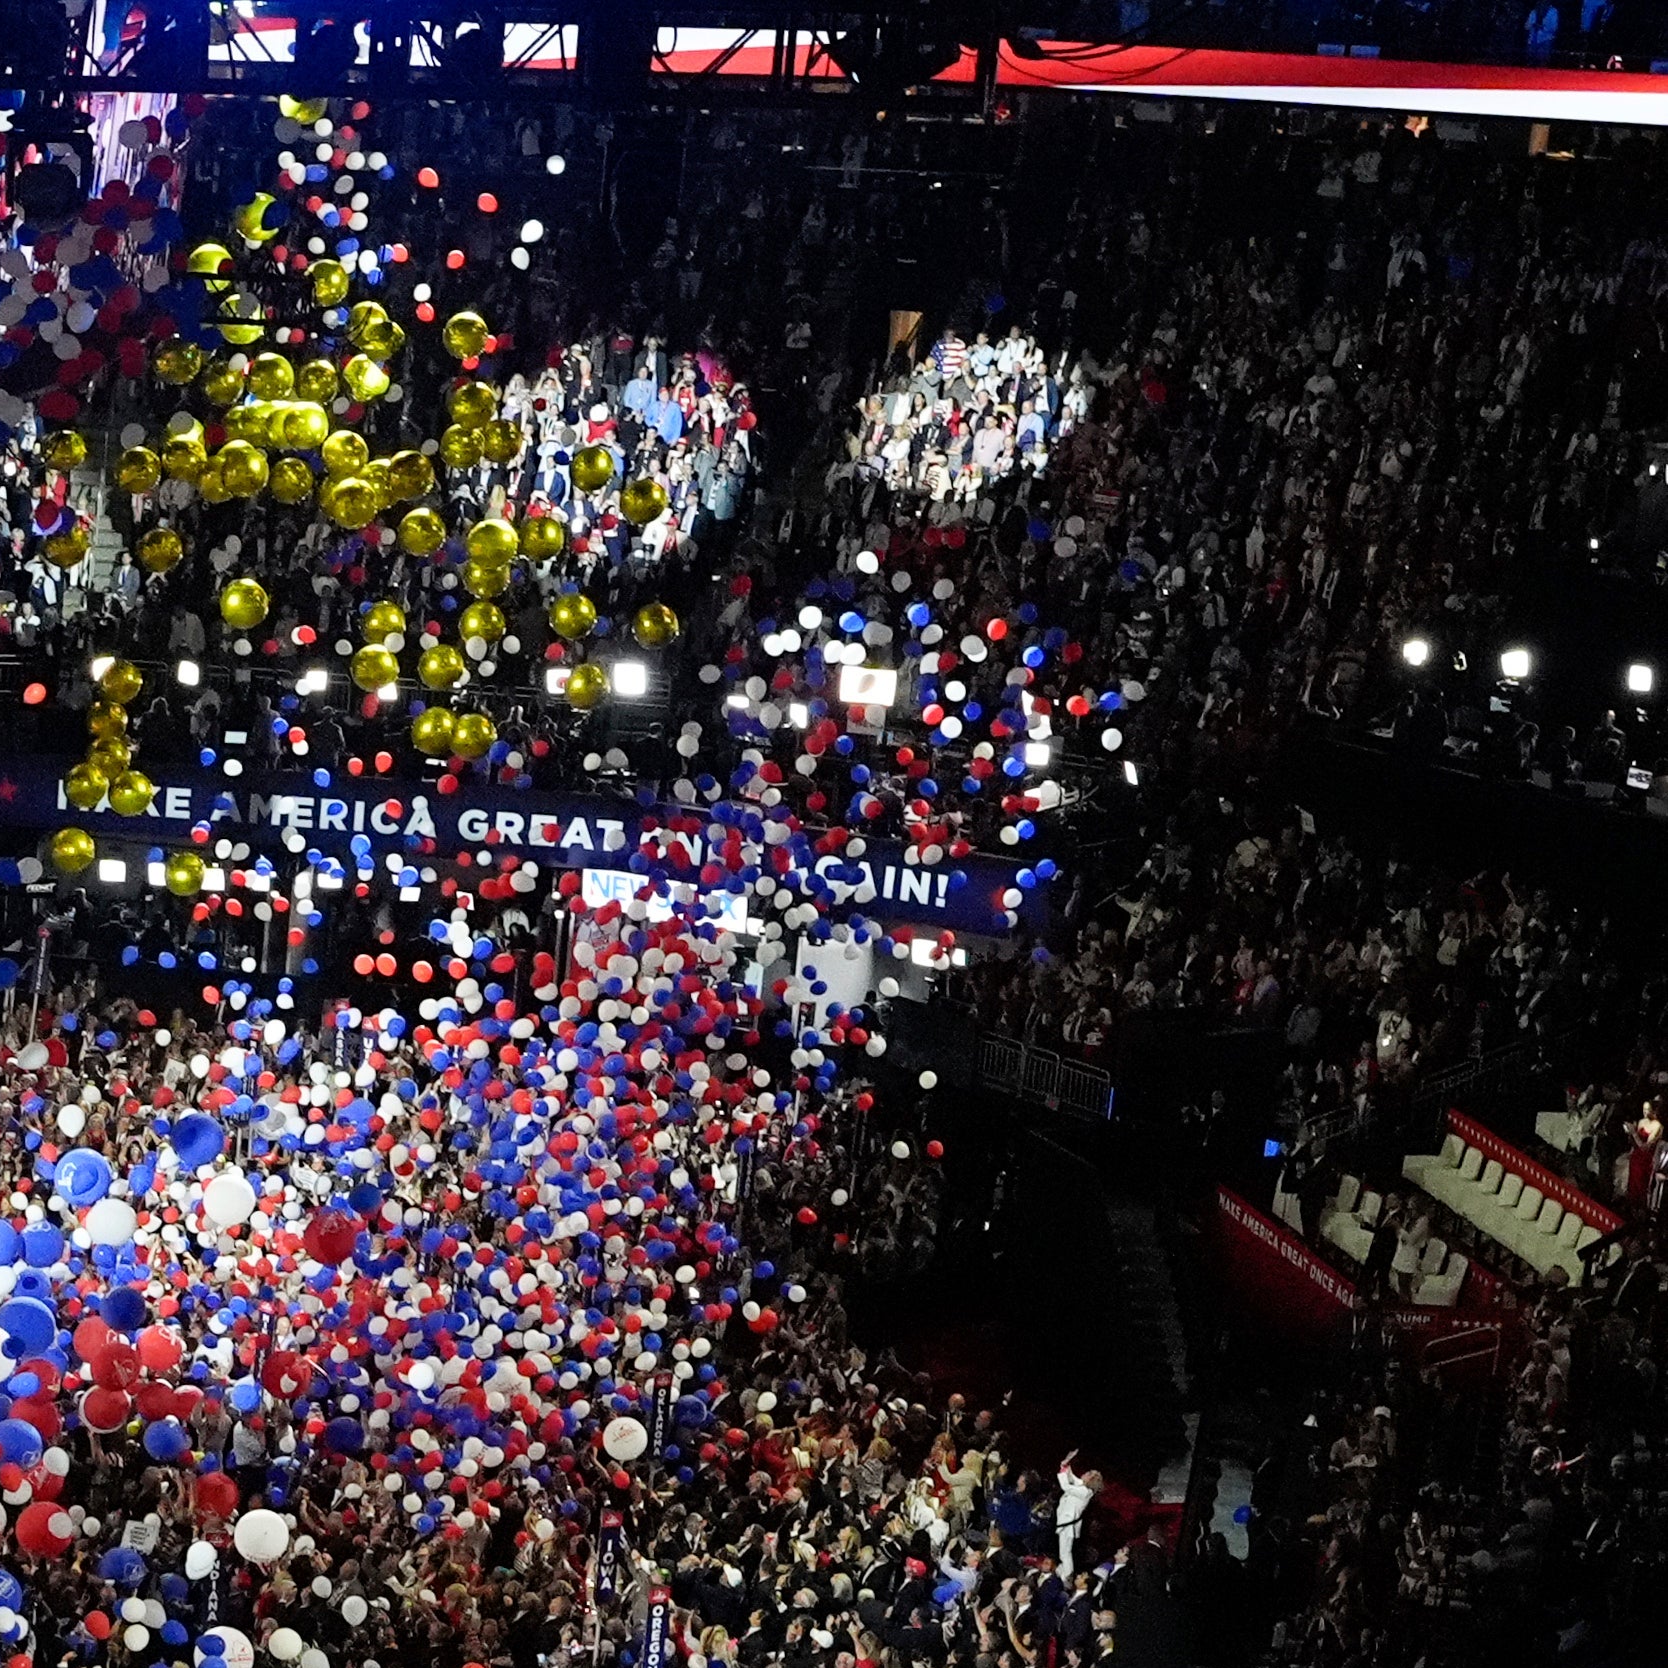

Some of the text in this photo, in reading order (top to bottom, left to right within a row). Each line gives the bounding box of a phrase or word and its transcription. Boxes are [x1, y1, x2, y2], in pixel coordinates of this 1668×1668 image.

[211, 791, 436, 838] AMERICA
[458, 809, 626, 852] GREAT
[1218, 1192, 1241, 1222] MAKE
[1242, 1213, 1279, 1251] AMERICA
[1280, 1241, 1310, 1273] GREAT
[1309, 1264, 1335, 1294] ONCE
[1395, 1314, 1431, 1324] RUMP
[653, 1389, 666, 1456] OKLAHOMA
[207, 1559, 220, 1622] NDIANA
[600, 1541, 615, 1590] IOWA
